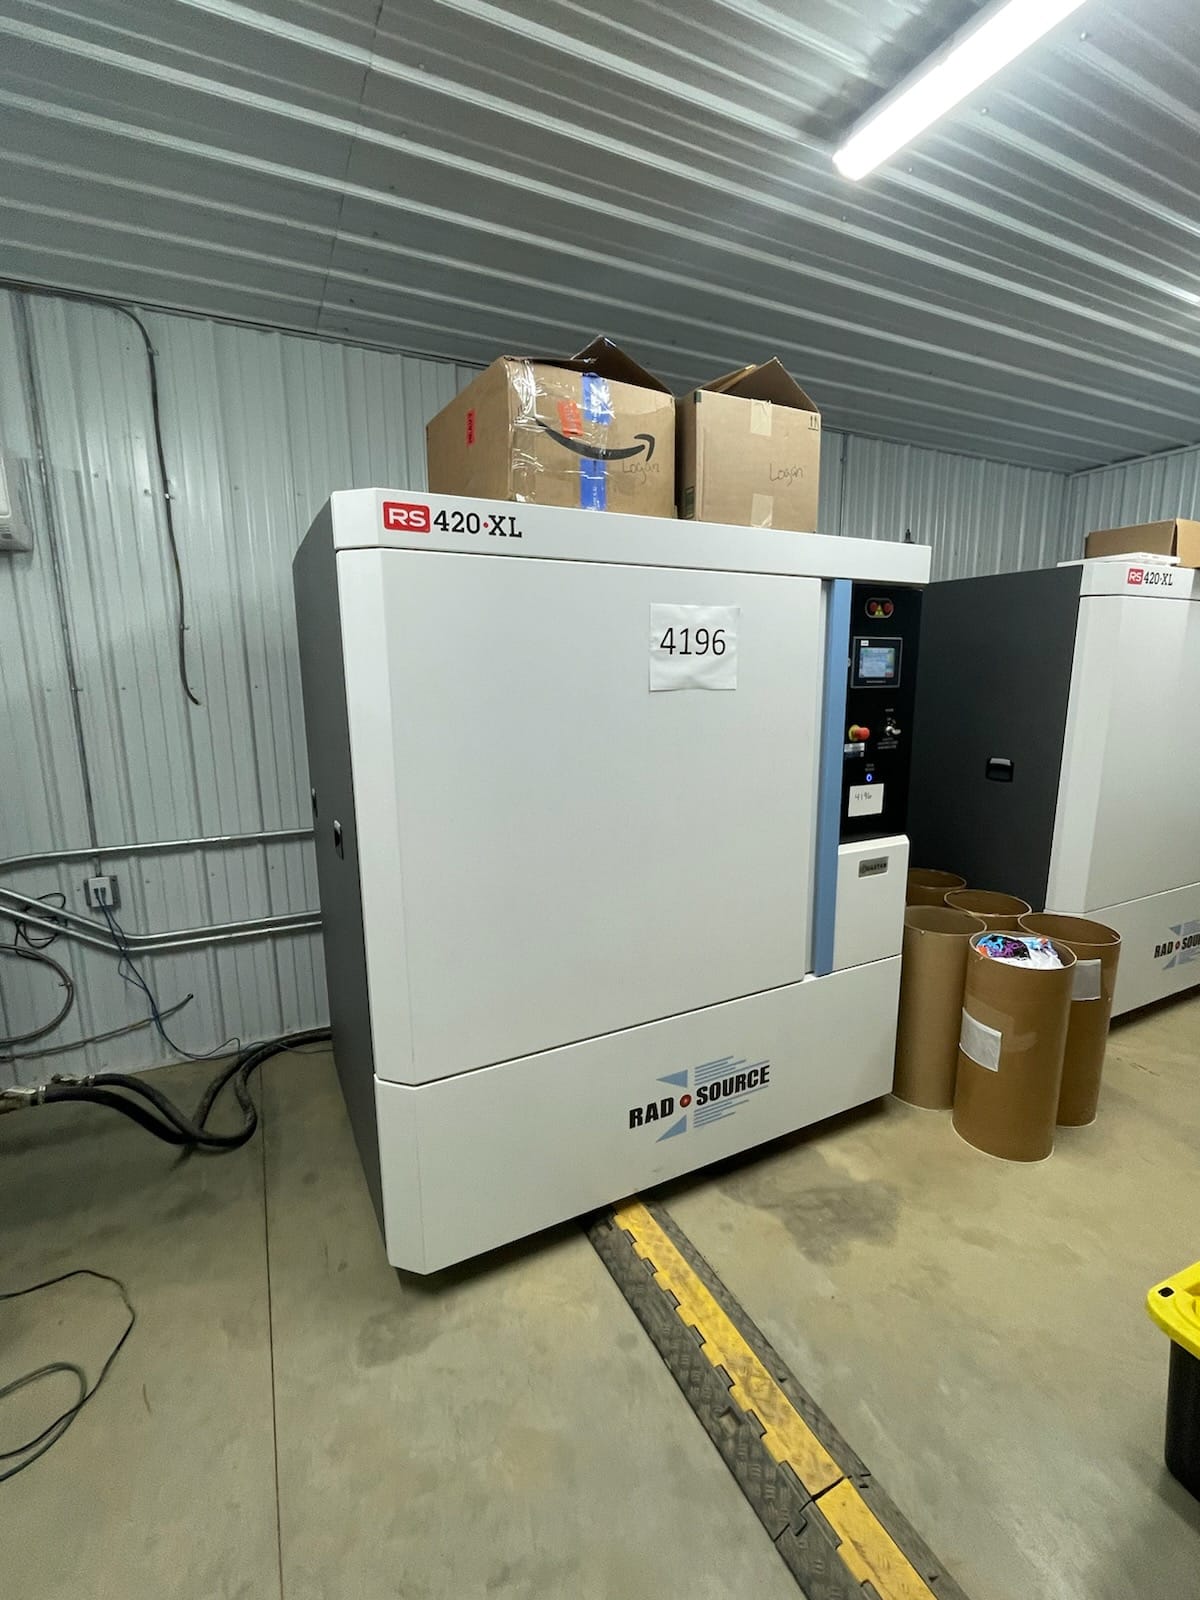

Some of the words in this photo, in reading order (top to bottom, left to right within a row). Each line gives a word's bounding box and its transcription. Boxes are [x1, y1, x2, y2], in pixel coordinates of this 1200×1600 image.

[387, 507, 427, 528] RS
[1128, 570, 1142, 583] RS
[659, 627, 726, 656] 4196
[1153, 941, 1174, 959] RAD
[629, 1097, 675, 1130] RAD
[696, 1064, 770, 1106] SOURCE
